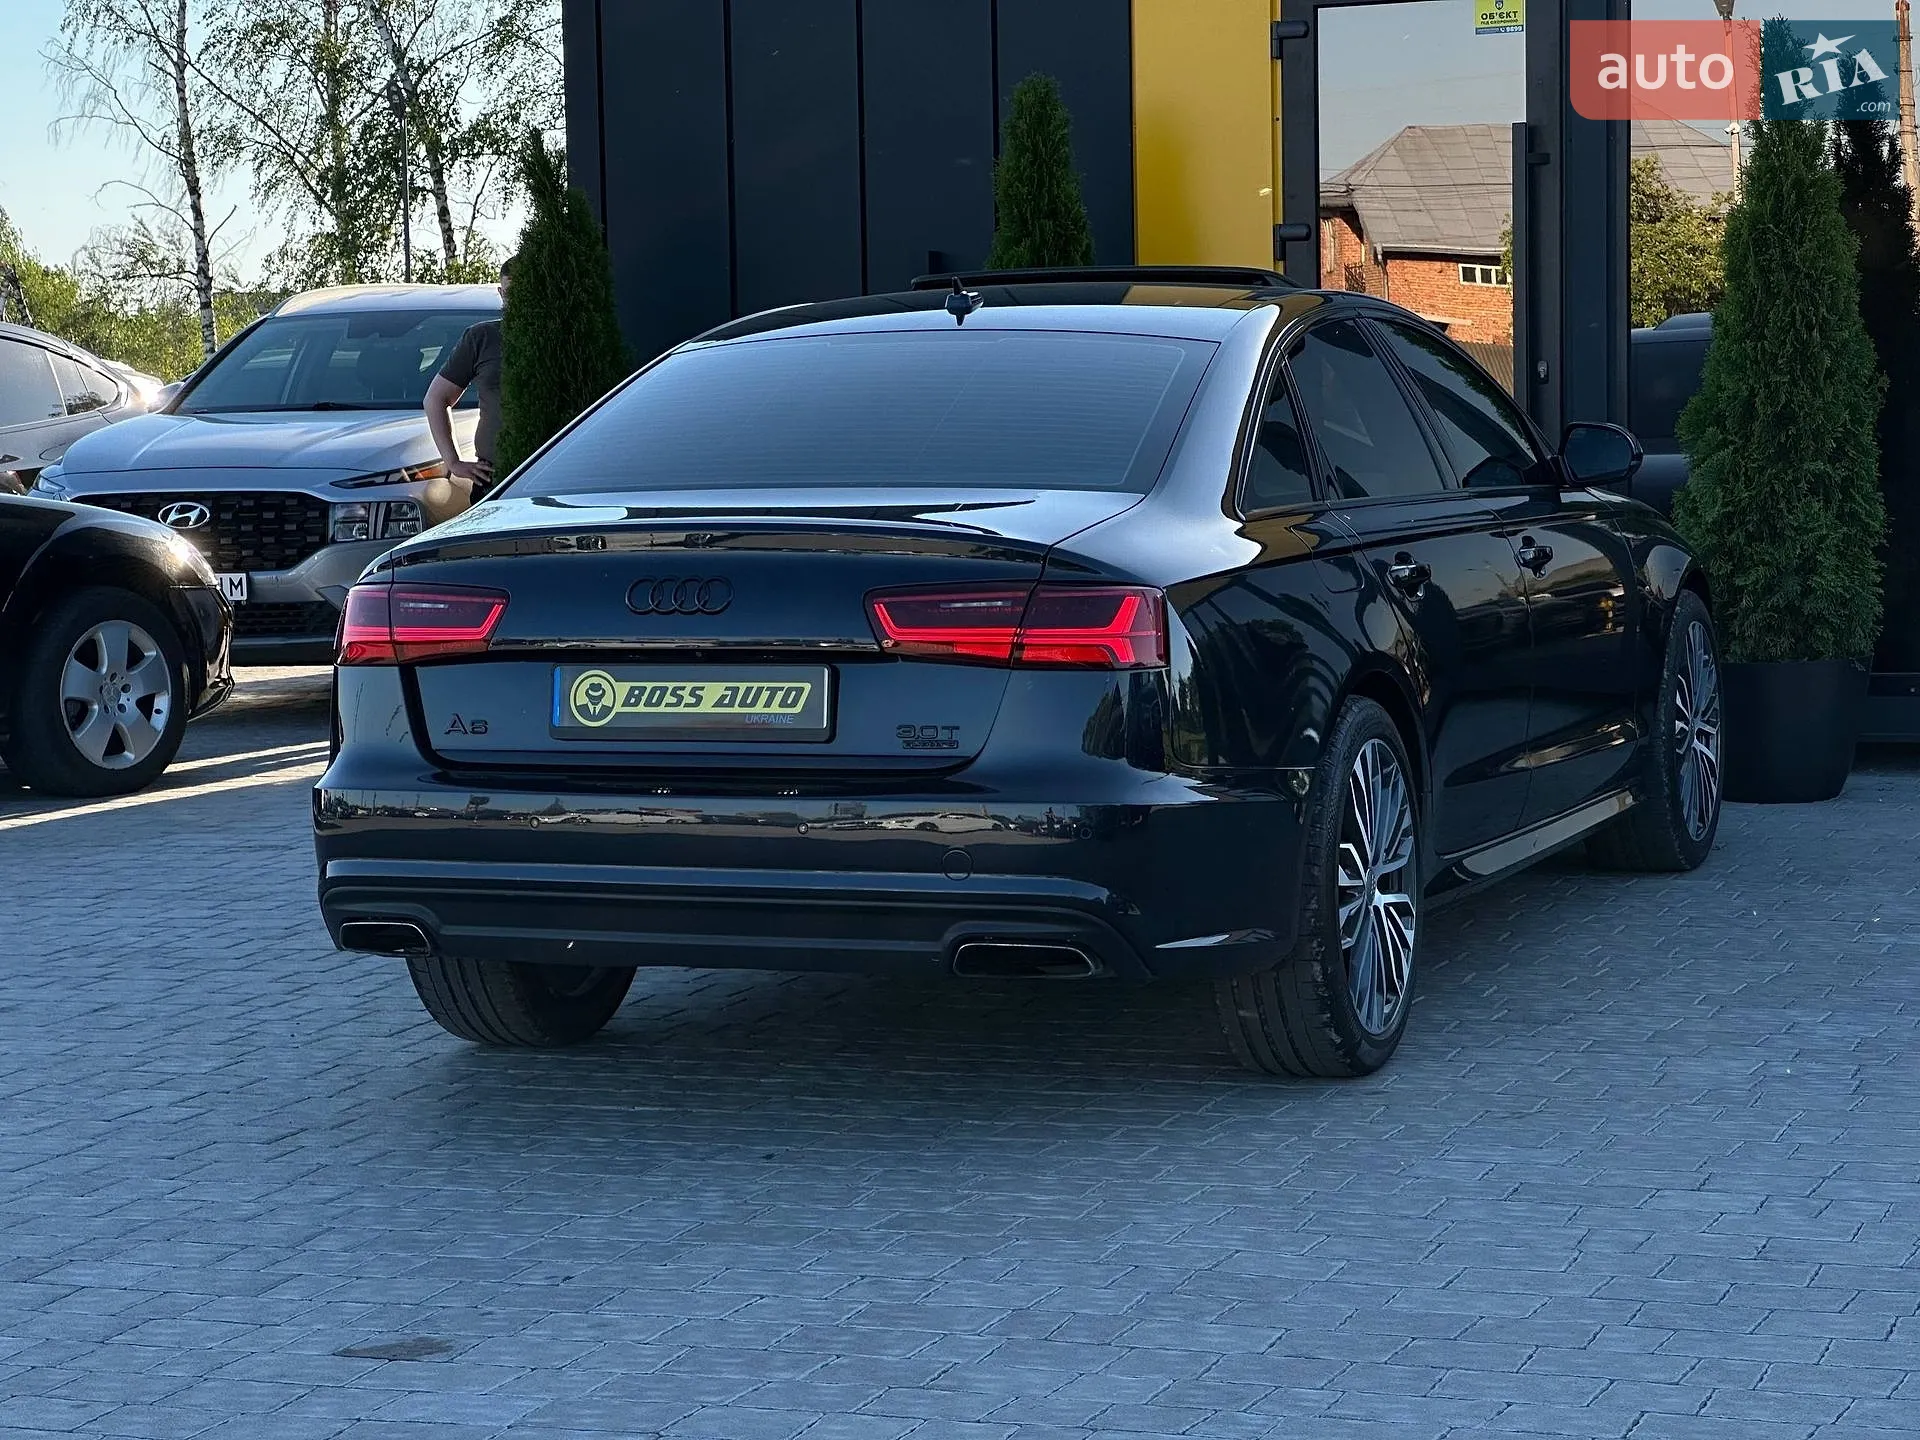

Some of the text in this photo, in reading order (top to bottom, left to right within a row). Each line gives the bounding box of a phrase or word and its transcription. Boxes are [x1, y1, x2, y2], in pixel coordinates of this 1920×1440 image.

[1480, 11, 1518, 20] ОБ'ЄКТ
[621, 686, 805, 709] BOSS AUTO
[443, 712, 489, 735] A6
[744, 714, 795, 725] UKRAINE
